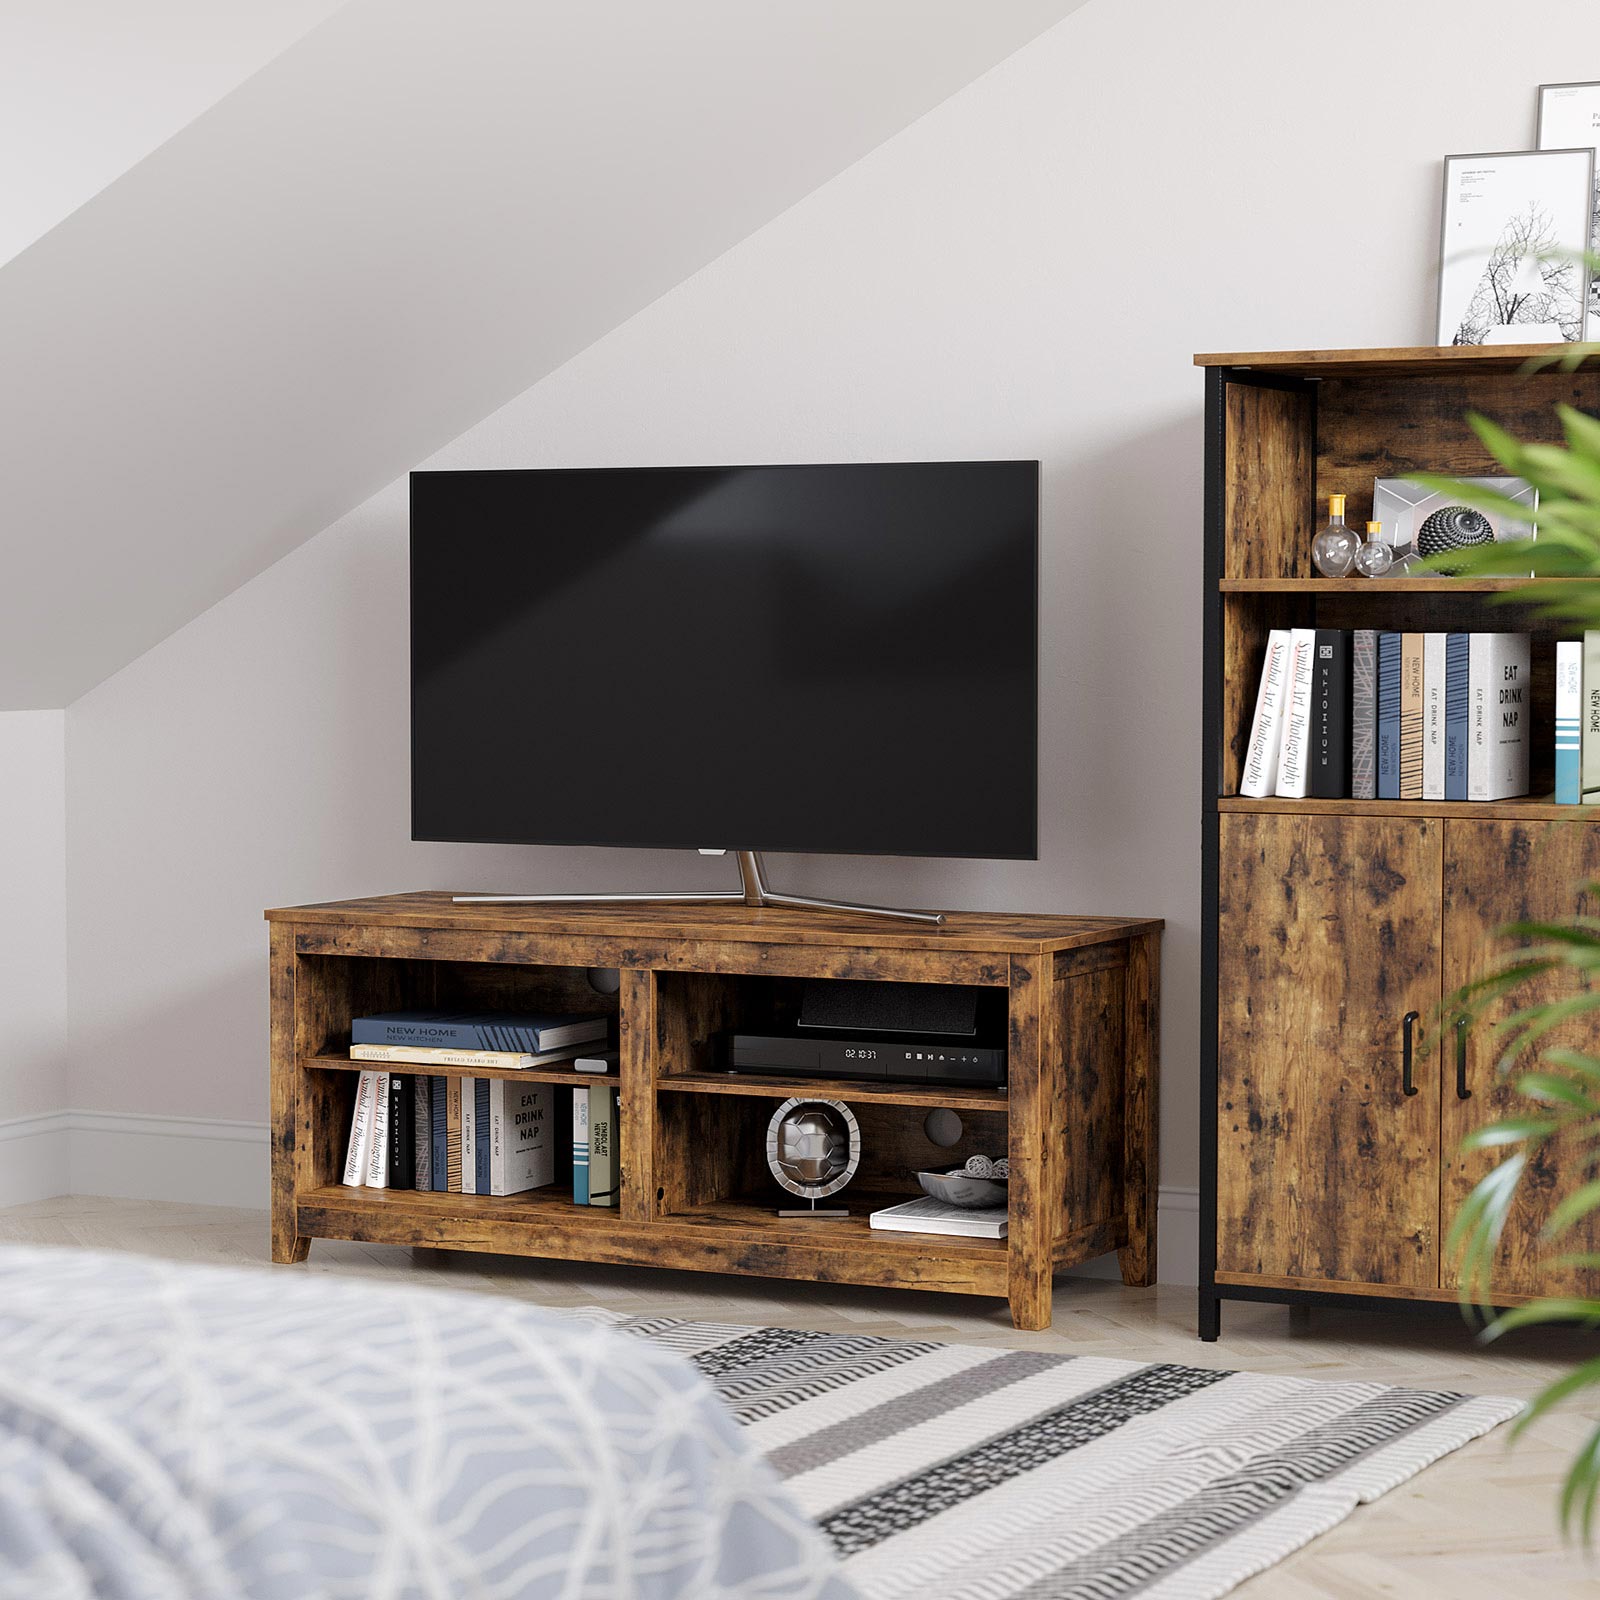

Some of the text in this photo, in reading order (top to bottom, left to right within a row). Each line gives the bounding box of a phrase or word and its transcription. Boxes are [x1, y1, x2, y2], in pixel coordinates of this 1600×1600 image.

[1412, 657, 1420, 698] NEW HOME
[1505, 666, 1517, 681] EAT
[1247, 642, 1285, 787] Symbol Art Photography
[1282, 640, 1311, 787] Symbol Art Photography
[1500, 688, 1522, 704] DRINK
[1591, 690, 1600, 732] NEW HOME
[1503, 712, 1518, 727] NAP
[1381, 735, 1389, 775] NEW HOME
[1448, 736, 1456, 776] NEW HOME
[387, 1026, 457, 1037] NEW HOME
[515, 1109, 544, 1125] DRINK
[521, 1094, 538, 1107] EAT
[347, 1076, 370, 1180] Symbol Art Photography
[369, 1075, 387, 1181] Symbol Art Photography
[520, 1127, 539, 1141] NAP
